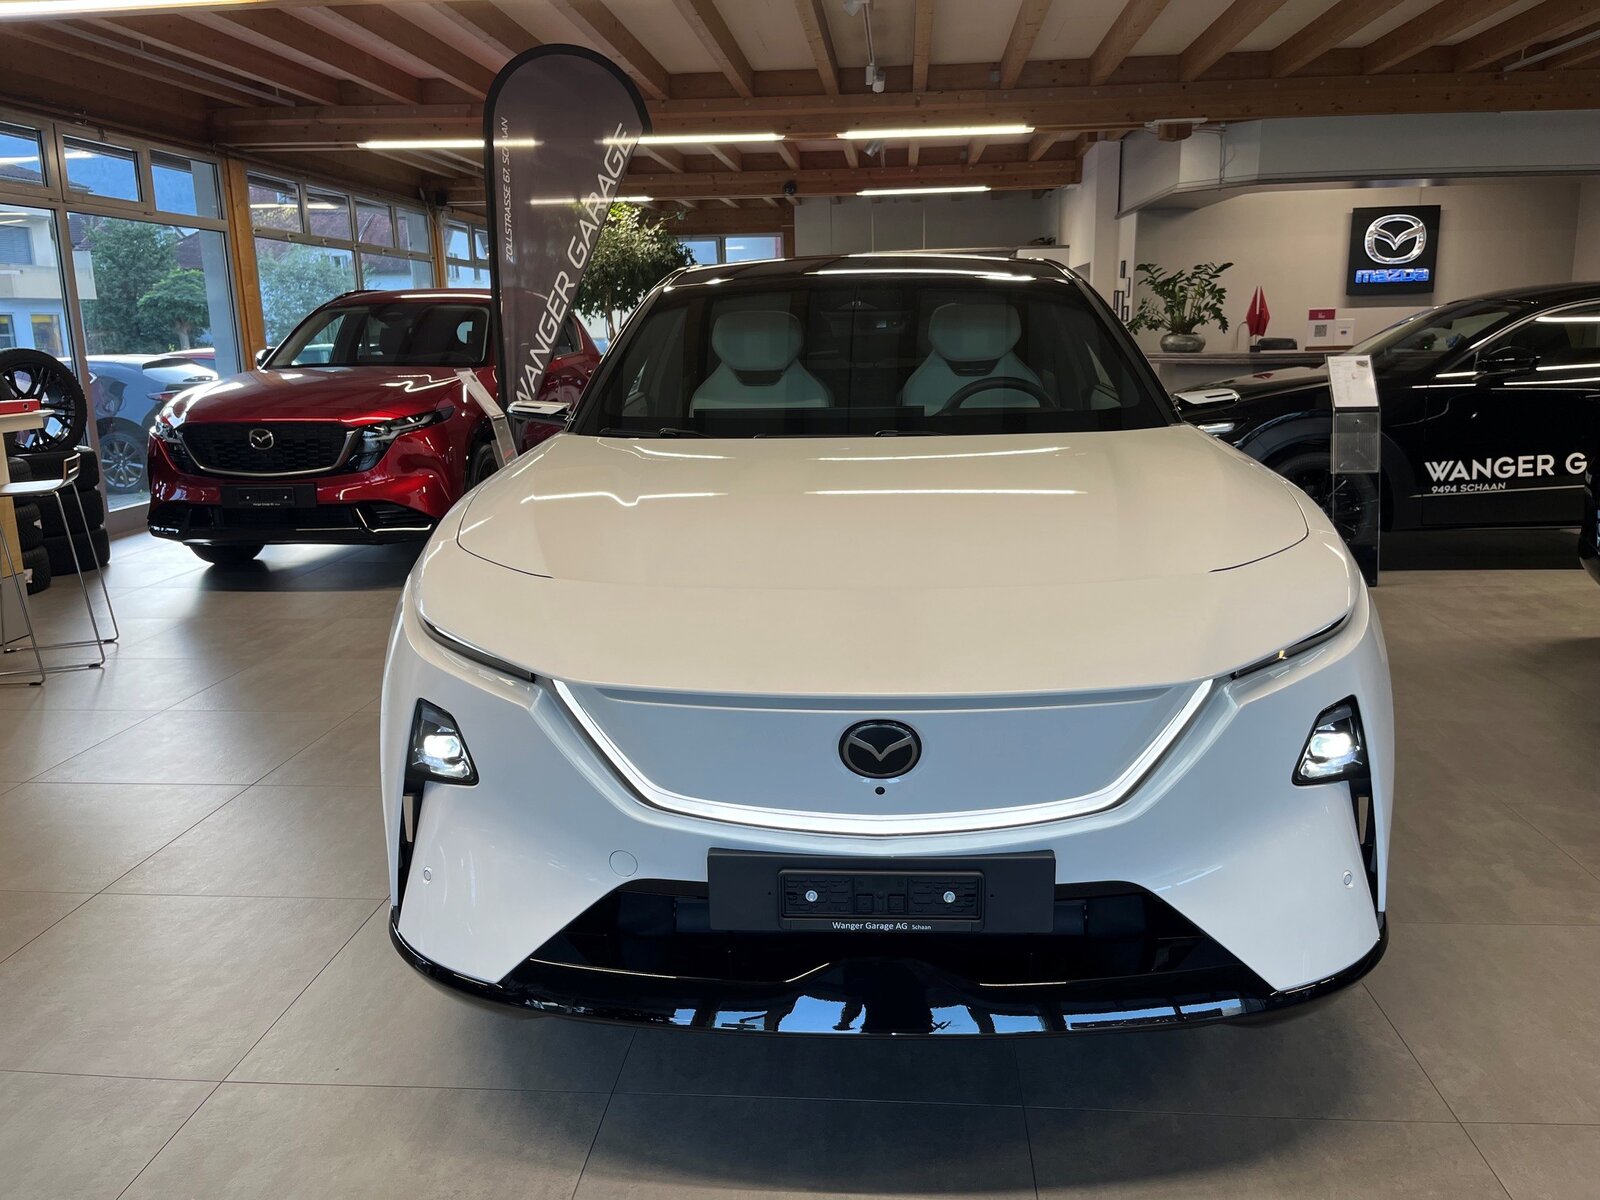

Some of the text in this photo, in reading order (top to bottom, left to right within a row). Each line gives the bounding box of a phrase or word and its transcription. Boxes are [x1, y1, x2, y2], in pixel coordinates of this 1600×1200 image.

[567, 122, 635, 269] GARAGE
[503, 184, 514, 264] ZOLLSTRASSE
[1424, 454, 1555, 482] WANGER
[1431, 482, 1506, 494] 9494 SCHAAN
[832, 922, 863, 931] Wanger
[865, 922, 894, 931] Garage
[895, 922, 908, 930] AG
